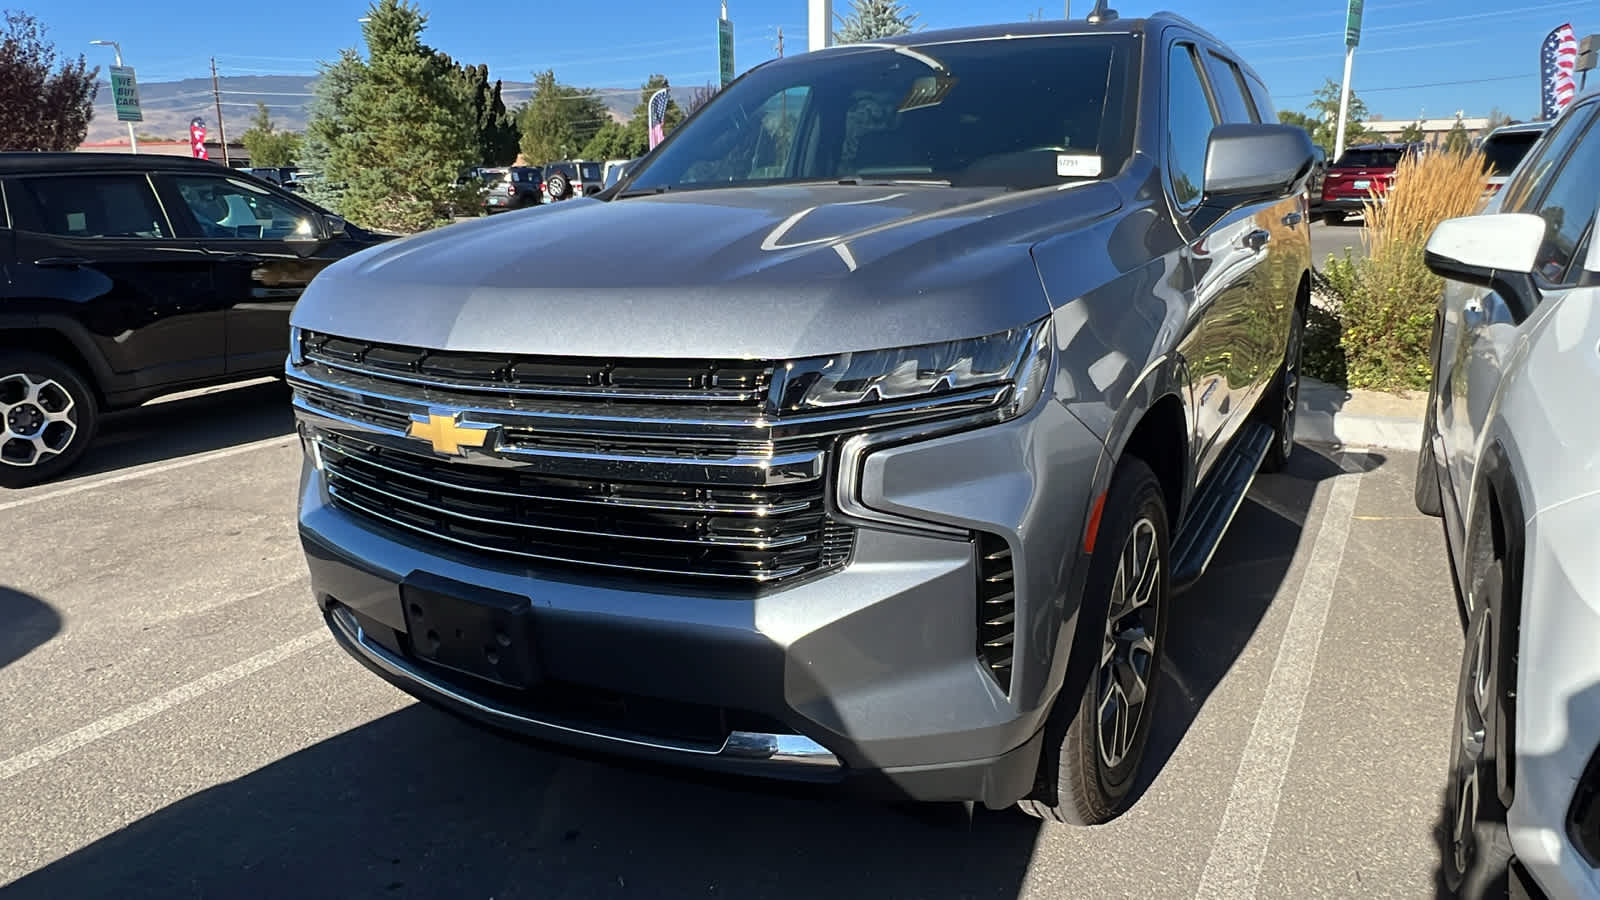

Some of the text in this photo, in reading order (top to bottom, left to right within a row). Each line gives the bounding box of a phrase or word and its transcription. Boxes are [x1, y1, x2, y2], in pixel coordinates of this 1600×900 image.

[118, 78, 132, 87] WE
[118, 88, 135, 97] BUY
[117, 98, 139, 107] CARS
